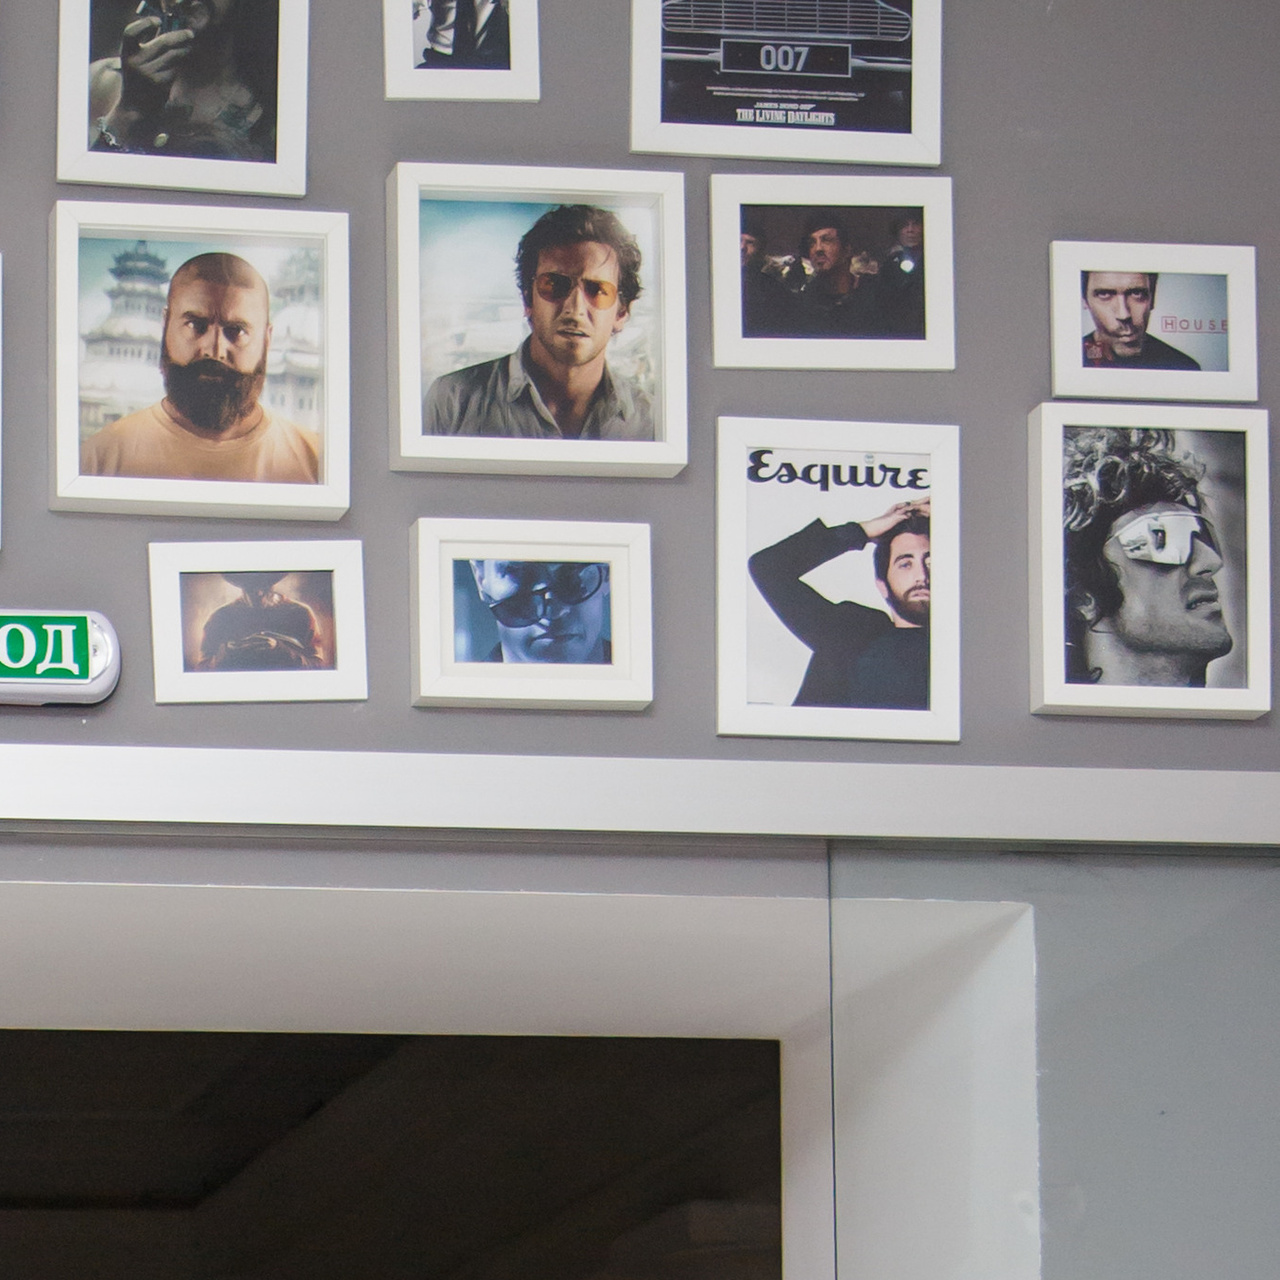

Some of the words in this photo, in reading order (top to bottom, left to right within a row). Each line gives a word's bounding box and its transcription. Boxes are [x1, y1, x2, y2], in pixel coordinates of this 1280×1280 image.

[760, 45, 810, 72] 007
[736, 108, 754, 122] THE
[755, 109, 786, 124] LIVING
[787, 110, 835, 126] DAYLIGHTS
[746, 449, 931, 492] Esquire
